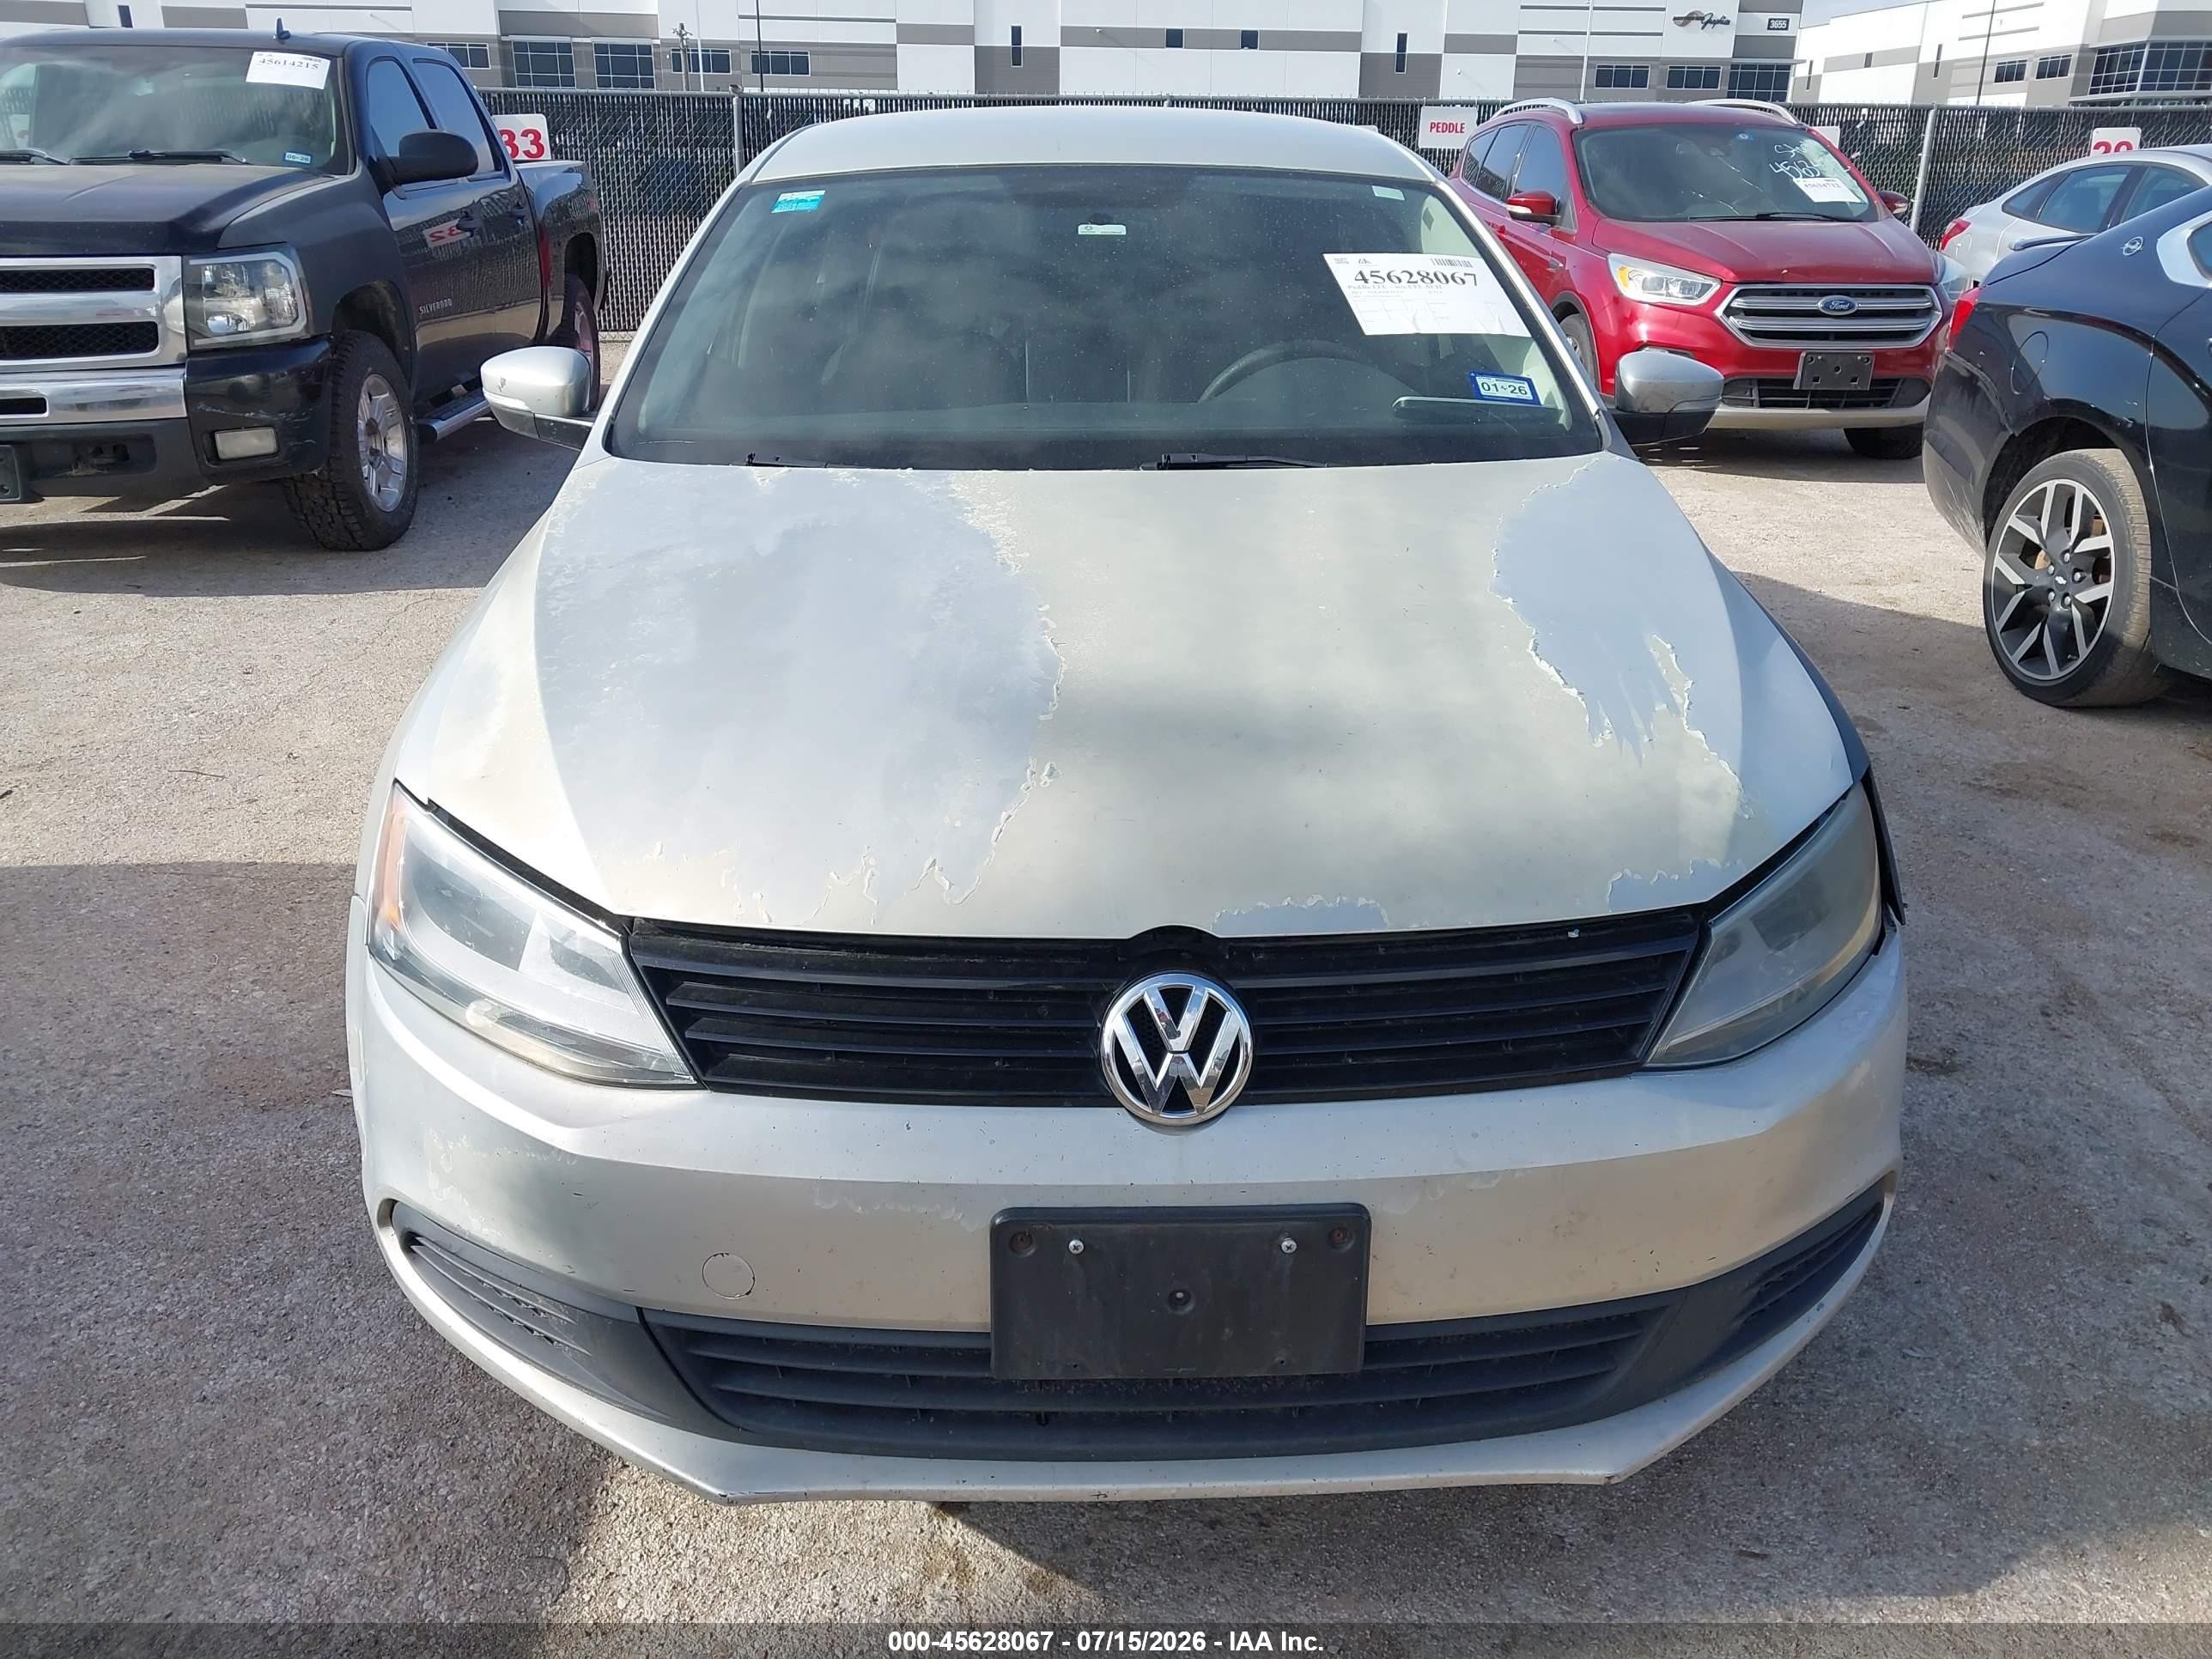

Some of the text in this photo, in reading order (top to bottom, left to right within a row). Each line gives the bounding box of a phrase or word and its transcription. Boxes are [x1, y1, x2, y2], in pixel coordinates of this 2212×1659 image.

[1769, 20, 1788, 29] 3655
[1429, 122, 1466, 134] PEDDLE
[1354, 270, 1479, 287] 45628067
[419, 298, 453, 314] SILVERADO
[1829, 299, 1850, 310] Ford
